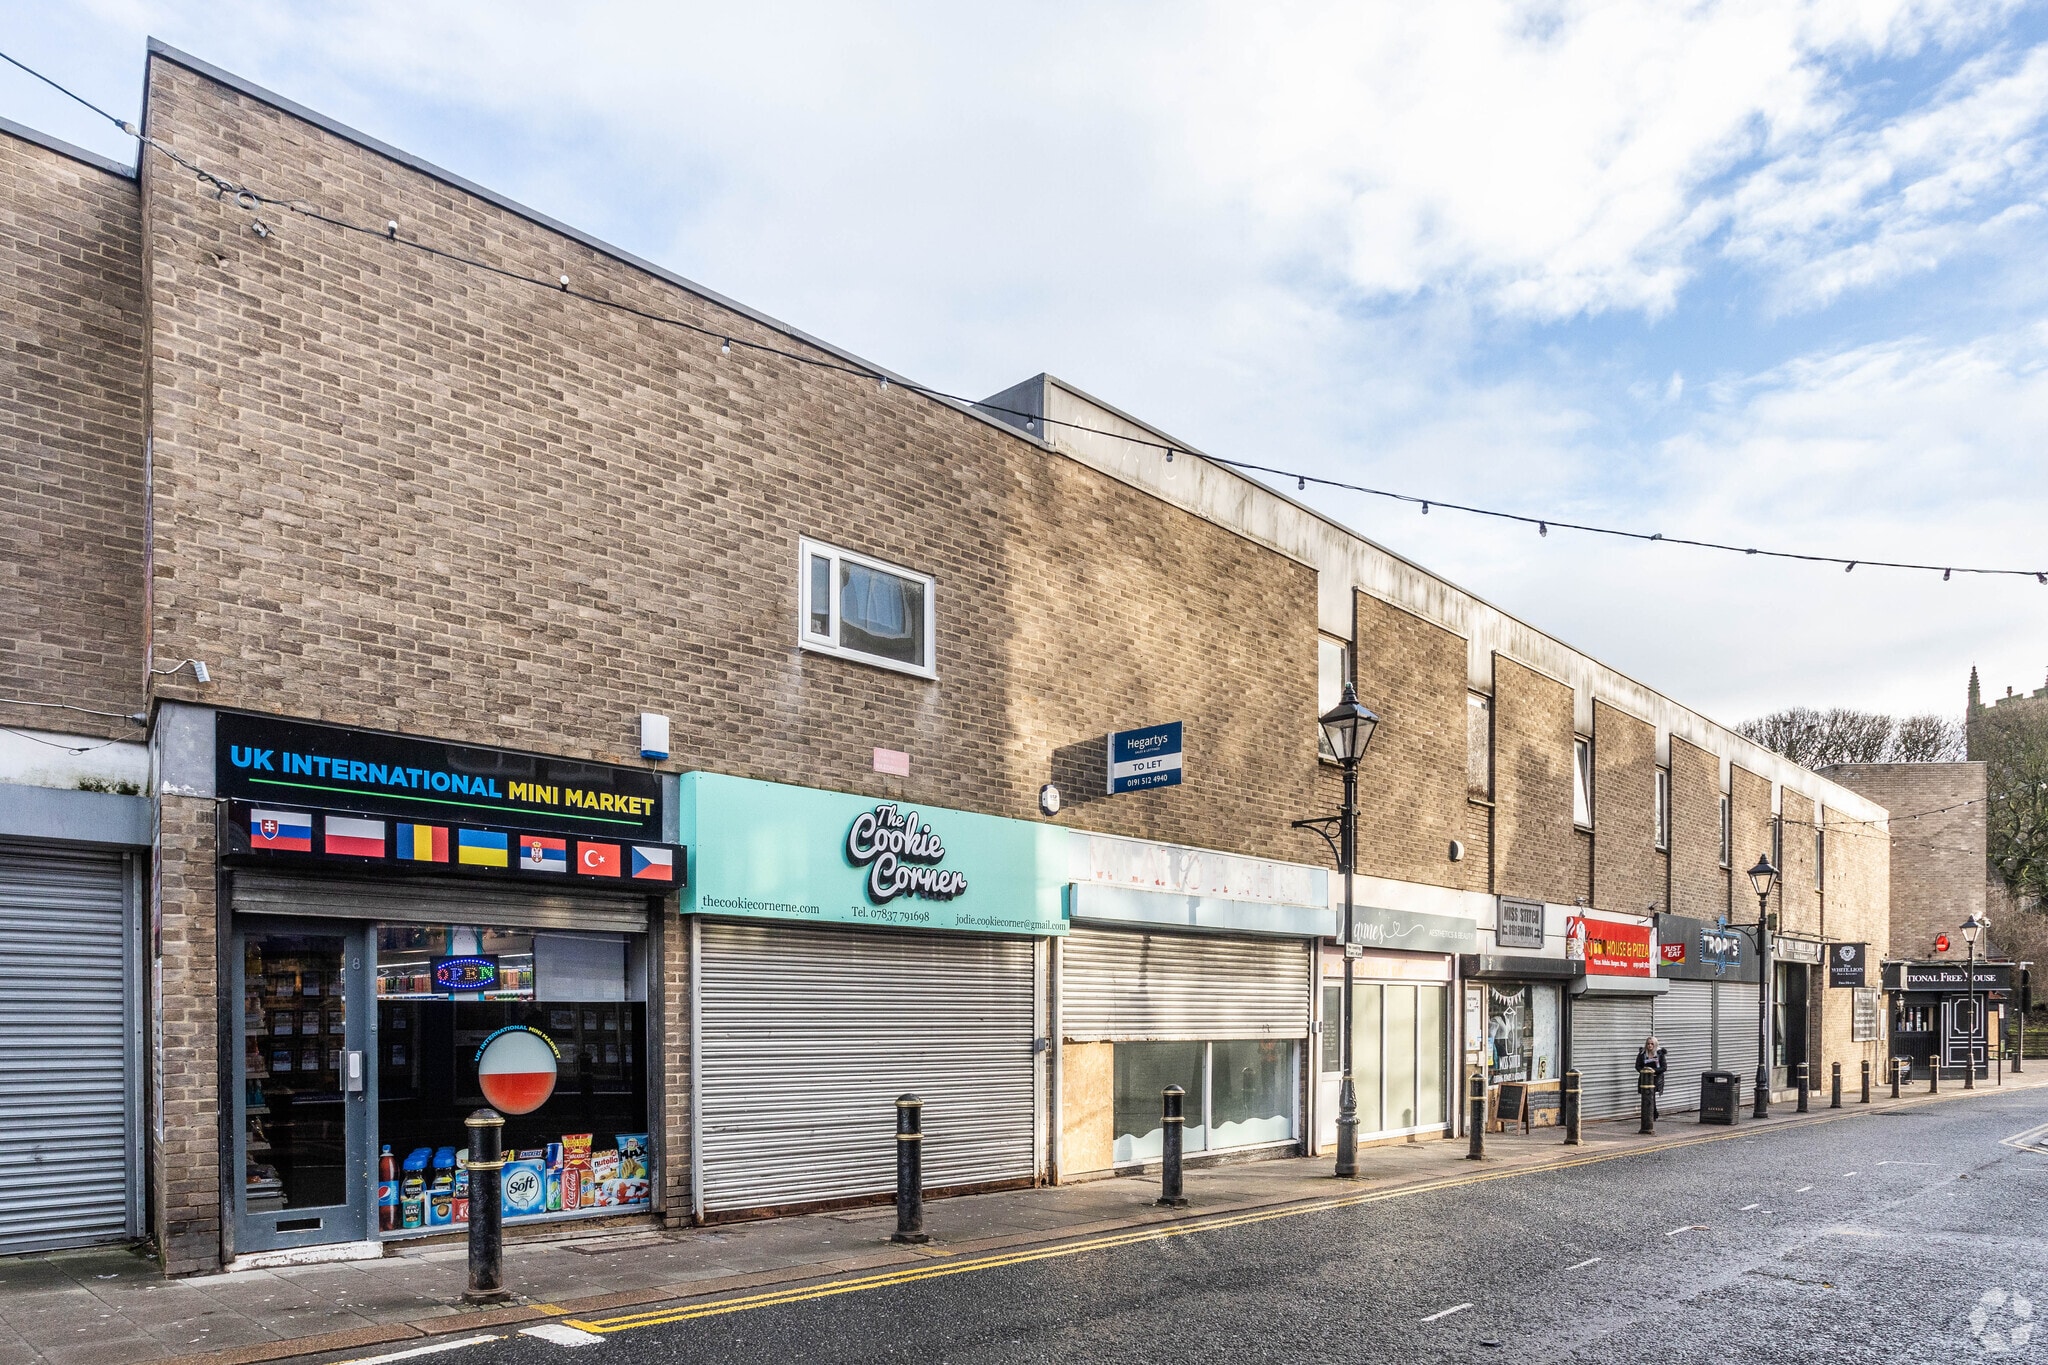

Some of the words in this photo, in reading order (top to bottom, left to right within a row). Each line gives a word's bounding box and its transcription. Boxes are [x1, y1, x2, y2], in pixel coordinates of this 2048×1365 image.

[1127, 735, 1168, 750] Hegartys
[1132, 762, 1145, 771] TO
[1146, 759, 1162, 769] LET
[231, 745, 274, 772] UK
[282, 751, 502, 798] INTERNATIONAL
[508, 780, 559, 805] MINI
[564, 788, 655, 816] MARKET
[1127, 778, 1140, 787] 0191
[1141, 776, 1152, 785] 512
[1153, 774, 1168, 783] 4940
[875, 804, 905, 828] The
[849, 810, 946, 860] Cookie
[870, 852, 967, 898] Corner
[702, 894, 820, 915] thecookiecornerne.com
[851, 905, 869, 918] Tel.
[870, 907, 897, 922] 07837
[899, 909, 930, 922] 791698
[955, 912, 1067, 931] jodie.cookiecorner@gmail.com
[1503, 906, 1518, 921] MISS
[1520, 908, 1539, 924] STITCH
[1606, 940, 1626, 956] HOUSE
[1626, 943, 1632, 957] &
[1632, 943, 1650, 958] PIZZA
[1664, 945, 1682, 953] JUST
[352, 957, 361, 970] 8
[436, 965, 495, 981] OPEN
[1940, 972, 1963, 982] FREE
[474, 1049, 482, 1062] UK
[480, 1024, 528, 1050] INTERNATIONAL
[528, 1026, 543, 1036] MINI
[541, 1033, 561, 1059] MARKET
[594, 1156, 618, 1167] nutella
[509, 1176, 535, 1195] Soft
